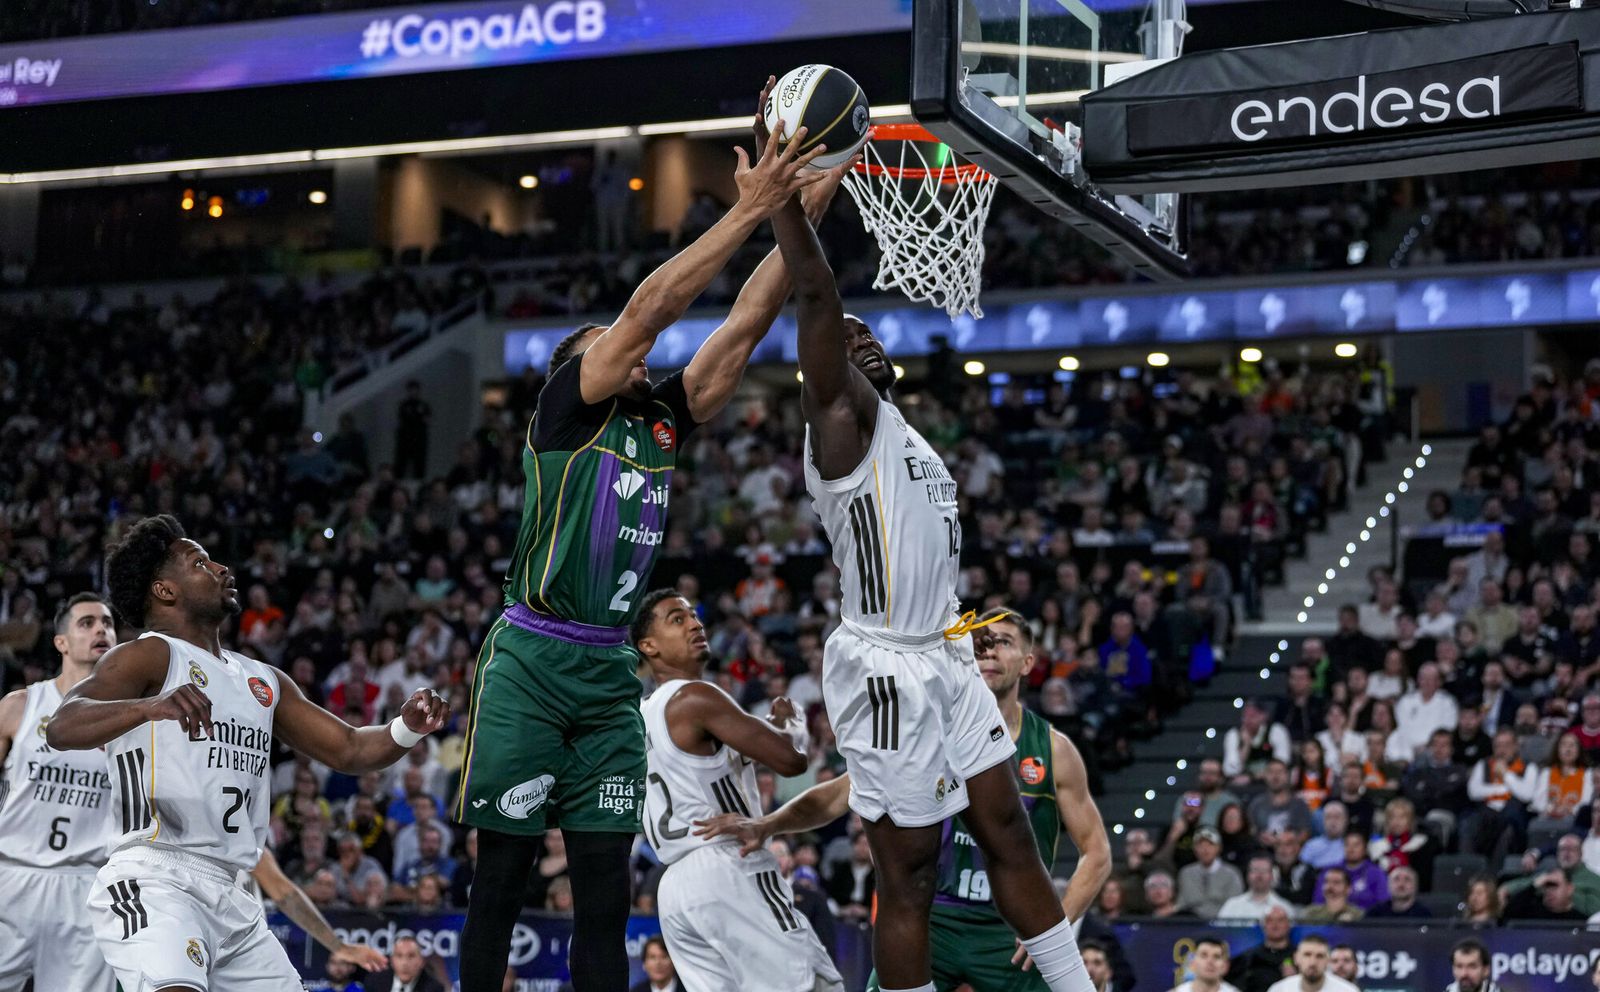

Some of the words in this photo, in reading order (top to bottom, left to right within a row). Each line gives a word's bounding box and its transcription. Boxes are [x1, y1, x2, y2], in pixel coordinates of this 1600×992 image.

[360, 1, 606, 58] #CopaACB
[14, 57, 63, 87] Rey
[1230, 75, 1500, 142] endesa
[609, 570, 638, 613] 2
[28, 760, 113, 791] Emirate
[207, 746, 230, 769] FLY
[233, 750, 268, 778] BETTER
[33, 784, 57, 803] FLY
[57, 787, 102, 809] BETTER
[598, 791, 635, 815] laga
[48, 816, 72, 852] 6
[957, 867, 991, 901] 19
[1491, 946, 1589, 984] pelayo
